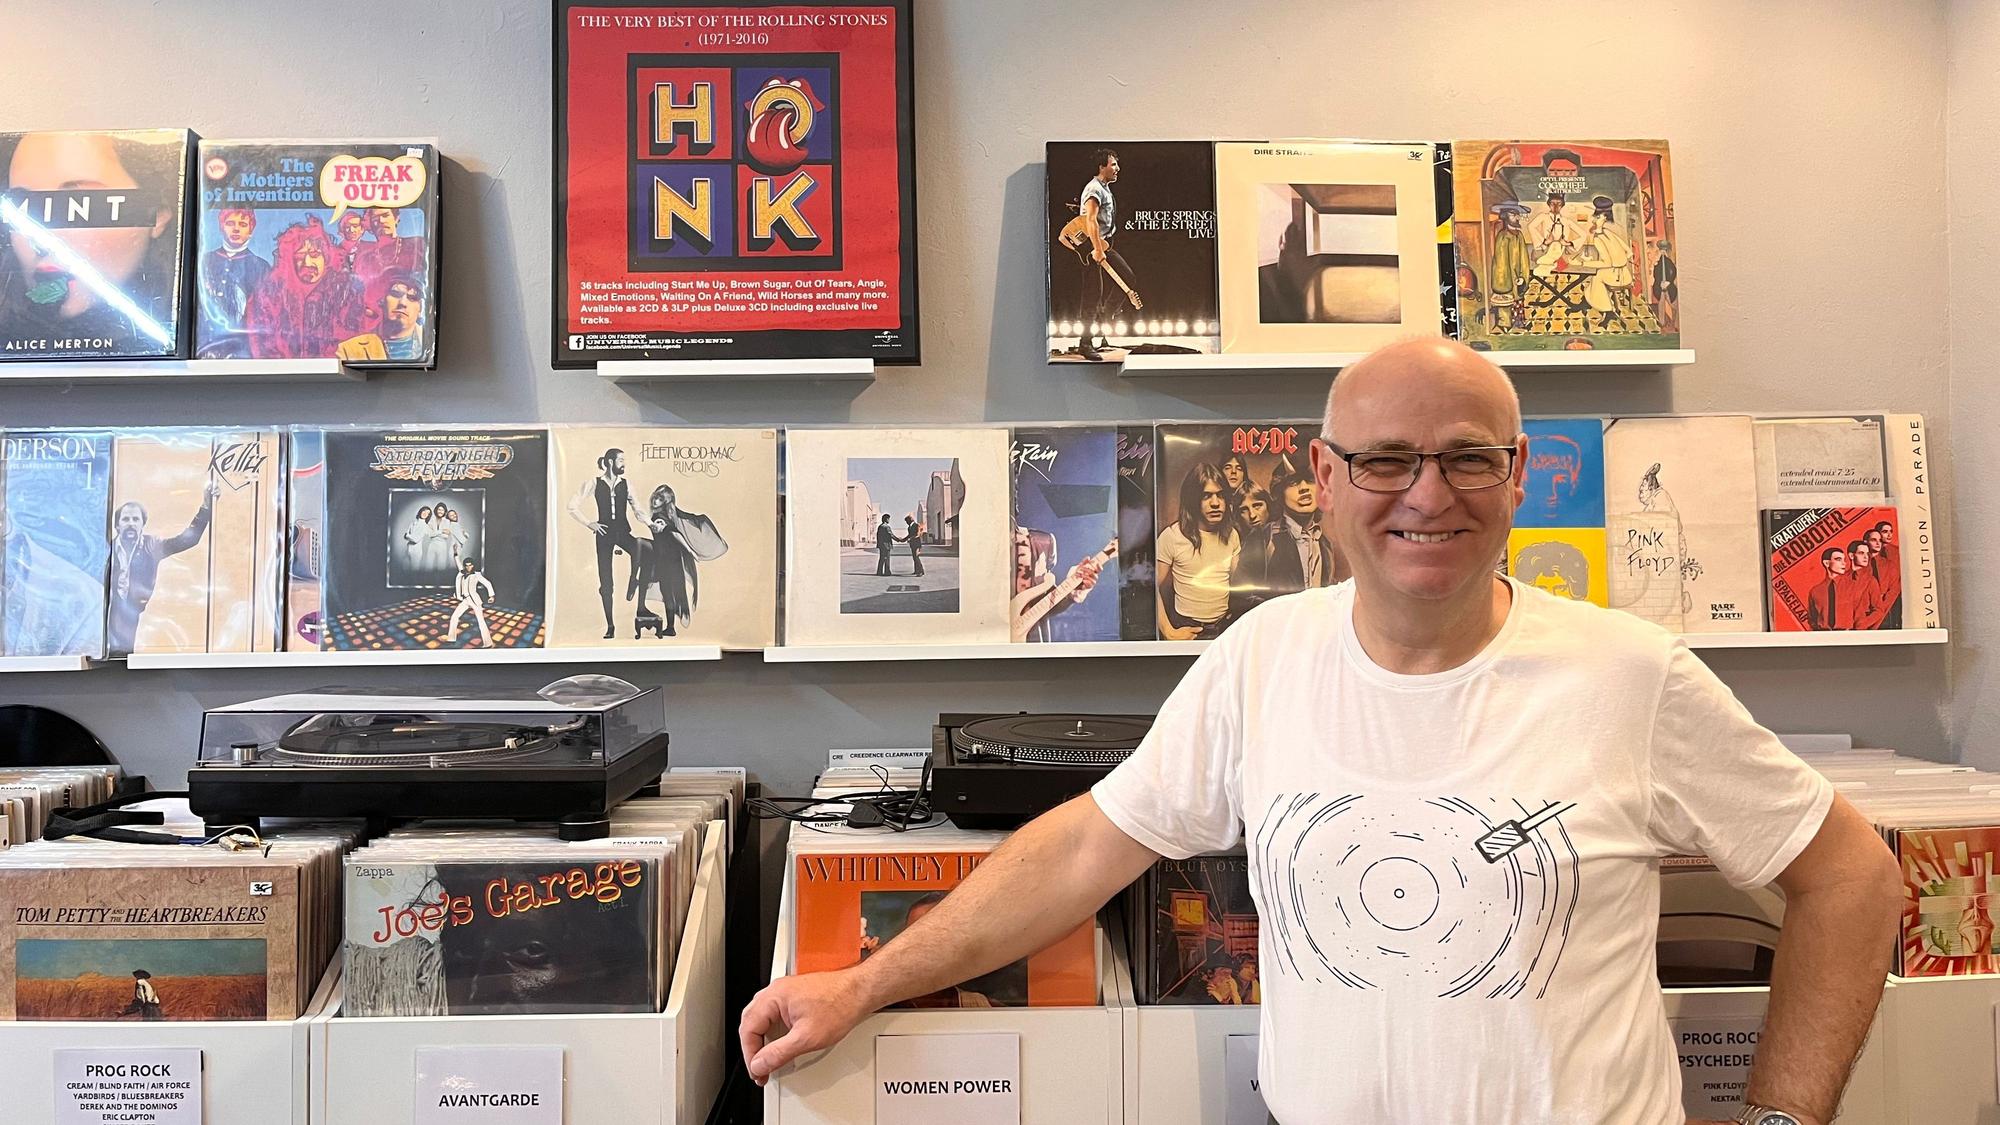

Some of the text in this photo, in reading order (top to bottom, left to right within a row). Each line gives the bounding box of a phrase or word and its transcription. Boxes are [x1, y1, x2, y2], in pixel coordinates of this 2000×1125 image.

[577, 14, 888, 28] THE VERY BEST OF THE ROLLING STONES
[698, 33, 769, 46] (1971-2016)
[280, 158, 315, 173] The
[333, 164, 413, 183] FREAK
[239, 173, 314, 188] Mothers
[204, 187, 314, 203] of Invention
[343, 183, 400, 201] OUT!
[1135, 210, 1171, 221] BRUCE
[1124, 219, 1214, 230] & THE E STREET
[580, 279, 887, 292] 36 tracks including Start Me Up, Brown Sugar, Out Of Tears, Angie,
[580, 291, 889, 303] Mixed Emotions, Waiting On A Friend, Wild Horses and many more.
[580, 301, 878, 314] Available as 2CD & 3LP plus Deluxe 3CD including exclusive live
[580, 316, 613, 325] tracks.
[5, 338, 114, 351] ALICE MERTON
[1909, 420, 1925, 495] PARADE
[411, 463, 468, 477] FEVER
[673, 460, 720, 478] RUMOURS
[1780, 468, 1814, 478] extended
[1780, 478, 1814, 487] extended
[1770, 508, 1821, 550] KRAFTWERK
[1625, 526, 1664, 552] PINK
[1773, 510, 1849, 574] DIE ROBOTER
[1627, 548, 1674, 576] FLOYD
[1711, 603, 1735, 611] RARE
[355, 866, 394, 878] Zappa
[802, 855, 948, 883] WHITNEY
[1165, 860, 1208, 872] BLUE
[373, 858, 642, 943] Joe's Garage
[16, 907, 51, 923] TOM
[55, 907, 111, 923] PETTY
[125, 906, 268, 923] HEARTBREAKERS
[1682, 1032, 1723, 1045] PROG
[86, 1064, 171, 1077] PROG ROCK
[66, 1081, 191, 1090] CREAM BLIND FAITH AIR FORCE
[884, 1079, 1012, 1095] WOMEN POWER
[1703, 1082, 1747, 1090] PINK FLOYD
[73, 1092, 185, 1100] YARDBIRDS BLUESBREAKERS
[438, 1093, 540, 1107] AVANTGARDE
[80, 1102, 178, 1111] DEREK AND THE DOMINOS
[102, 1113, 155, 1121] ERIC CLAPTON
